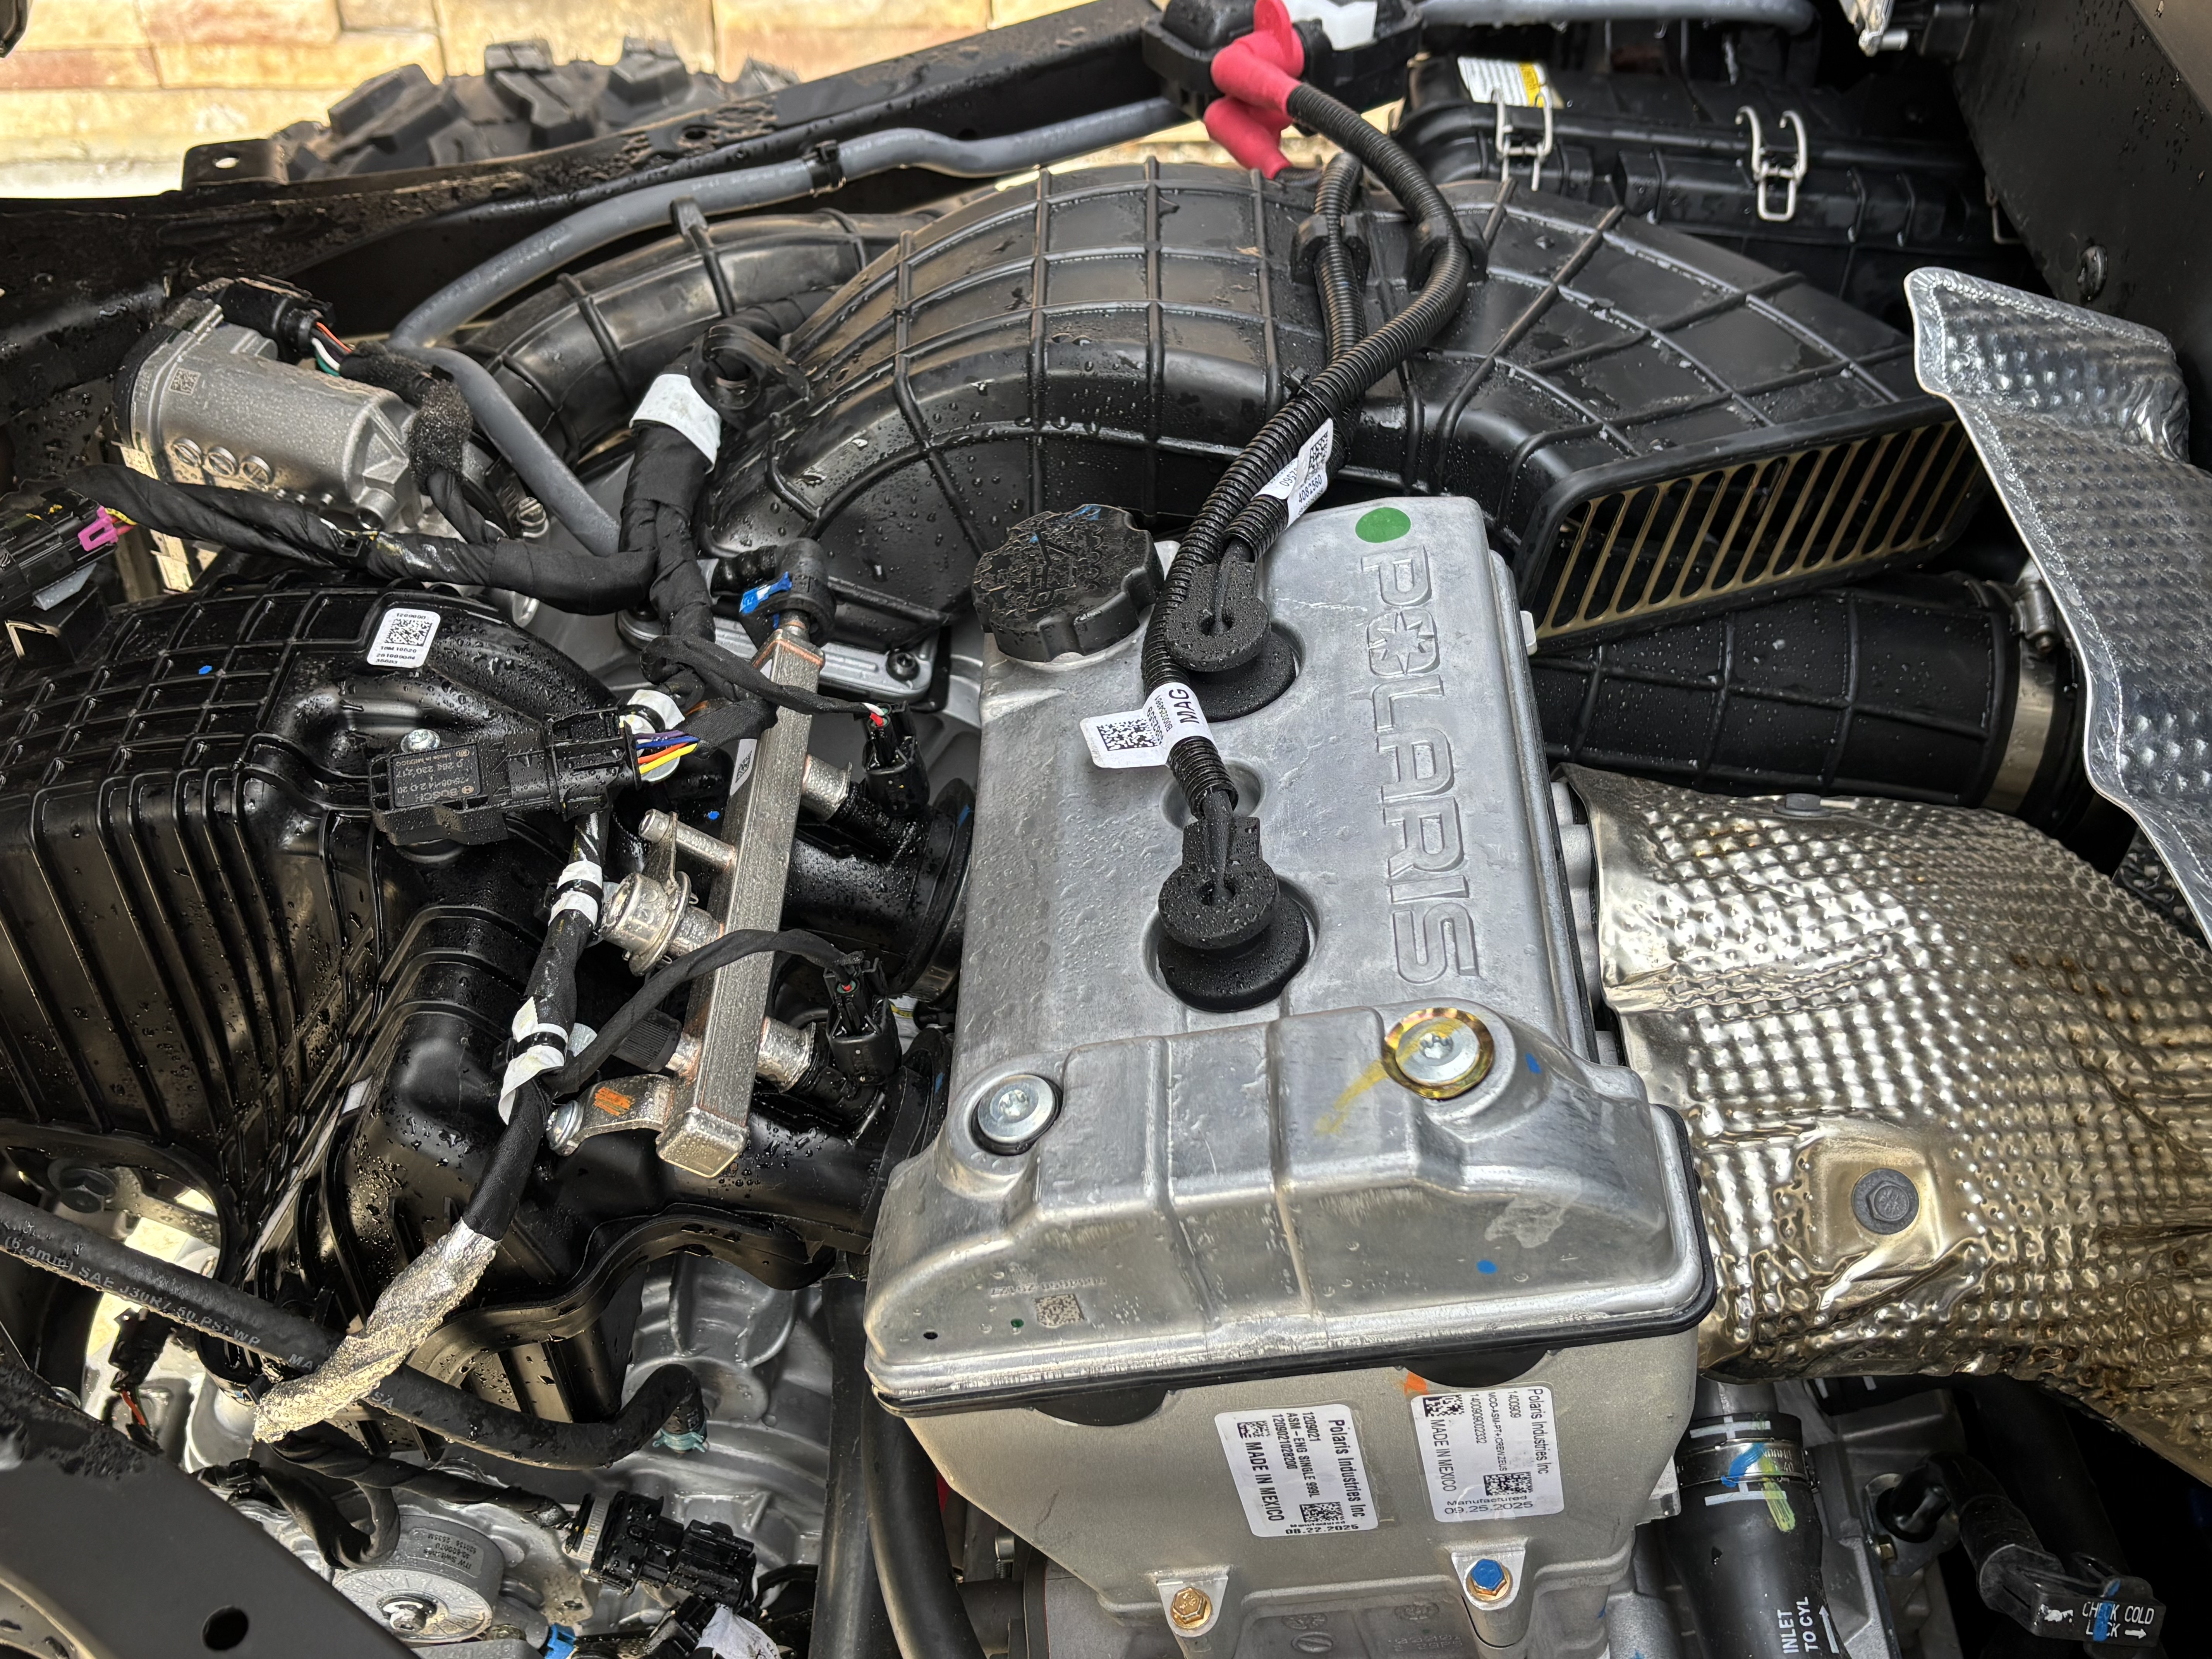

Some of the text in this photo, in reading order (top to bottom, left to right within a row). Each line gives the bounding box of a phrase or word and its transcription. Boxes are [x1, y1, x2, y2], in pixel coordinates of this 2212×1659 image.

[1298, 474, 1322, 503] 4082560
[1168, 689, 1200, 724] MAG
[1361, 546, 1479, 984] POLARIS
[415, 788, 459, 802] BOSCH
[79, 1266, 115, 1288] SAE
[1508, 1391, 1522, 1418] 1400909
[1286, 1413, 1302, 1429] ASM
[1302, 1412, 1321, 1441] 1209021
[1470, 1394, 1487, 1444] 1400909002332
[1527, 1388, 1552, 1474] Polaris Industries Inc
[1272, 1413, 1298, 1469] 1209021028200
[1293, 1437, 1308, 1453] ENG
[1430, 1419, 1457, 1491] MADE IN MEXICO
[1245, 1442, 1285, 1521] MADE IN MEXICO
[1298, 1455, 1316, 1480] SINGLE
[1328, 1419, 1366, 1517] Polaris Industries Inc
[1444, 1501, 1533, 1514] 09.25.2025
[1447, 1495, 1527, 1506] Manufactured
[1285, 1524, 1359, 1534] 08.22.2025
[458, 1559, 472, 1569] ITW
[1796, 1596, 1819, 1652] TO CYL
[2086, 1620, 2121, 1638] LCK
[2124, 1606, 2155, 1625] COLD
[1777, 1609, 1799, 1654] INLET
